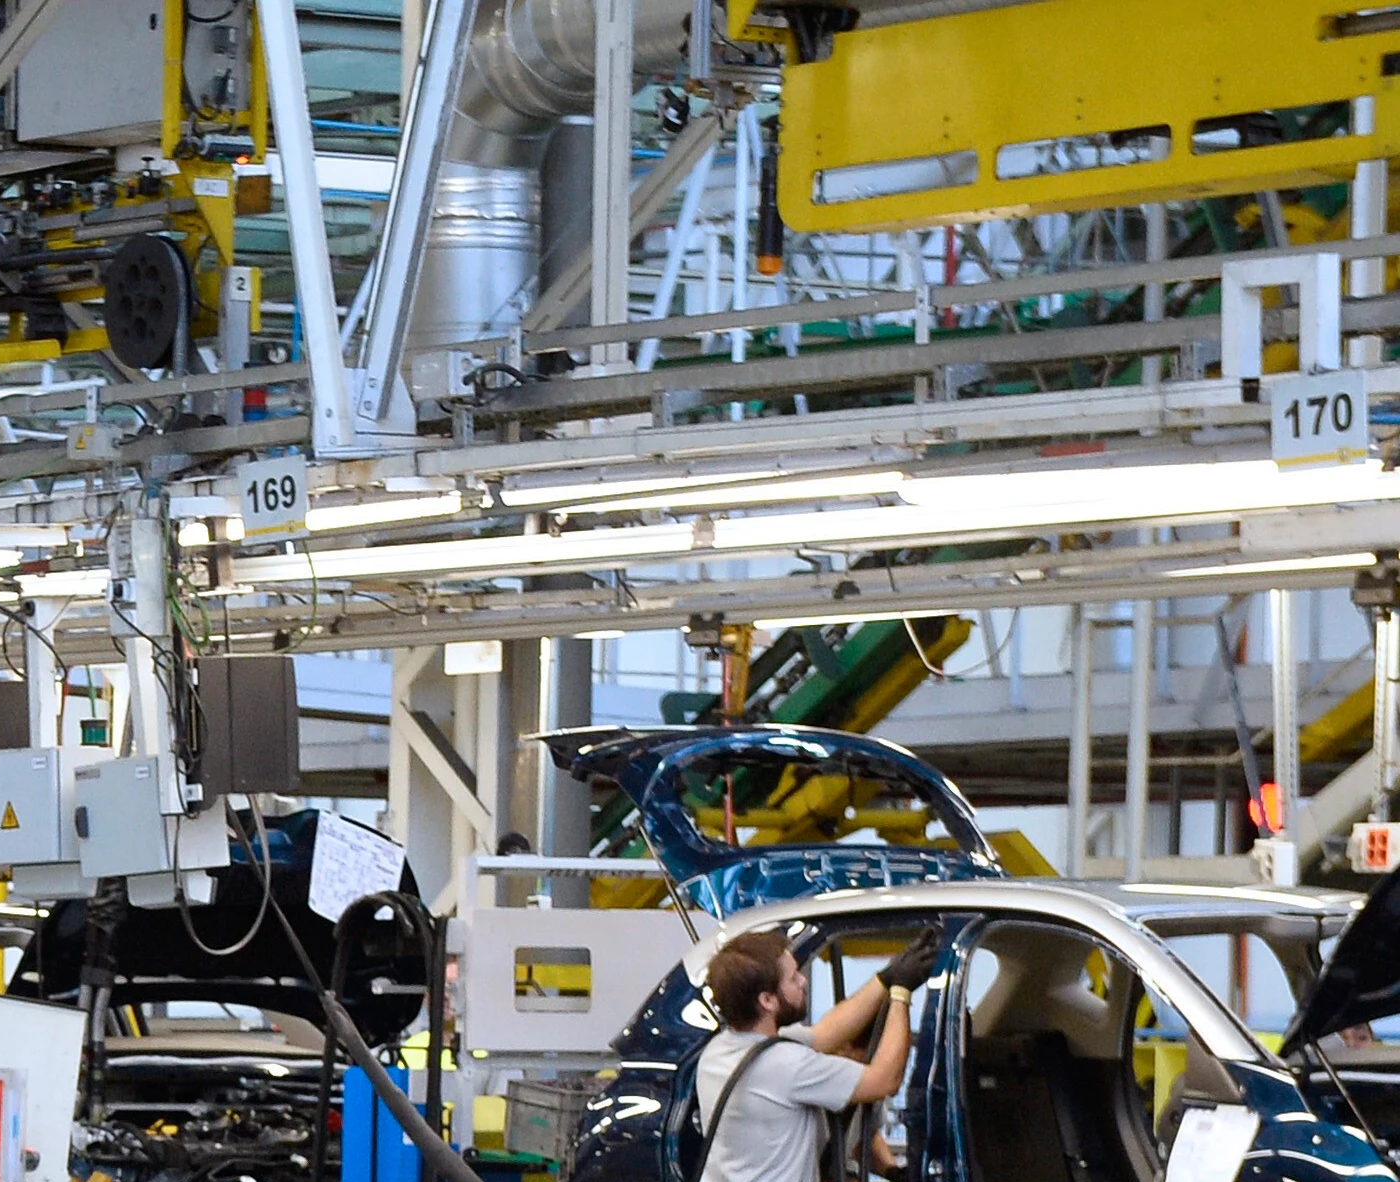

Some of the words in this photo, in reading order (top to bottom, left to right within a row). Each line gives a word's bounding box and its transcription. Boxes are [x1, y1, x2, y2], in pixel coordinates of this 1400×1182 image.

[235, 276, 246, 291] 2
[1283, 392, 1353, 438] 170
[247, 474, 297, 513] 169
